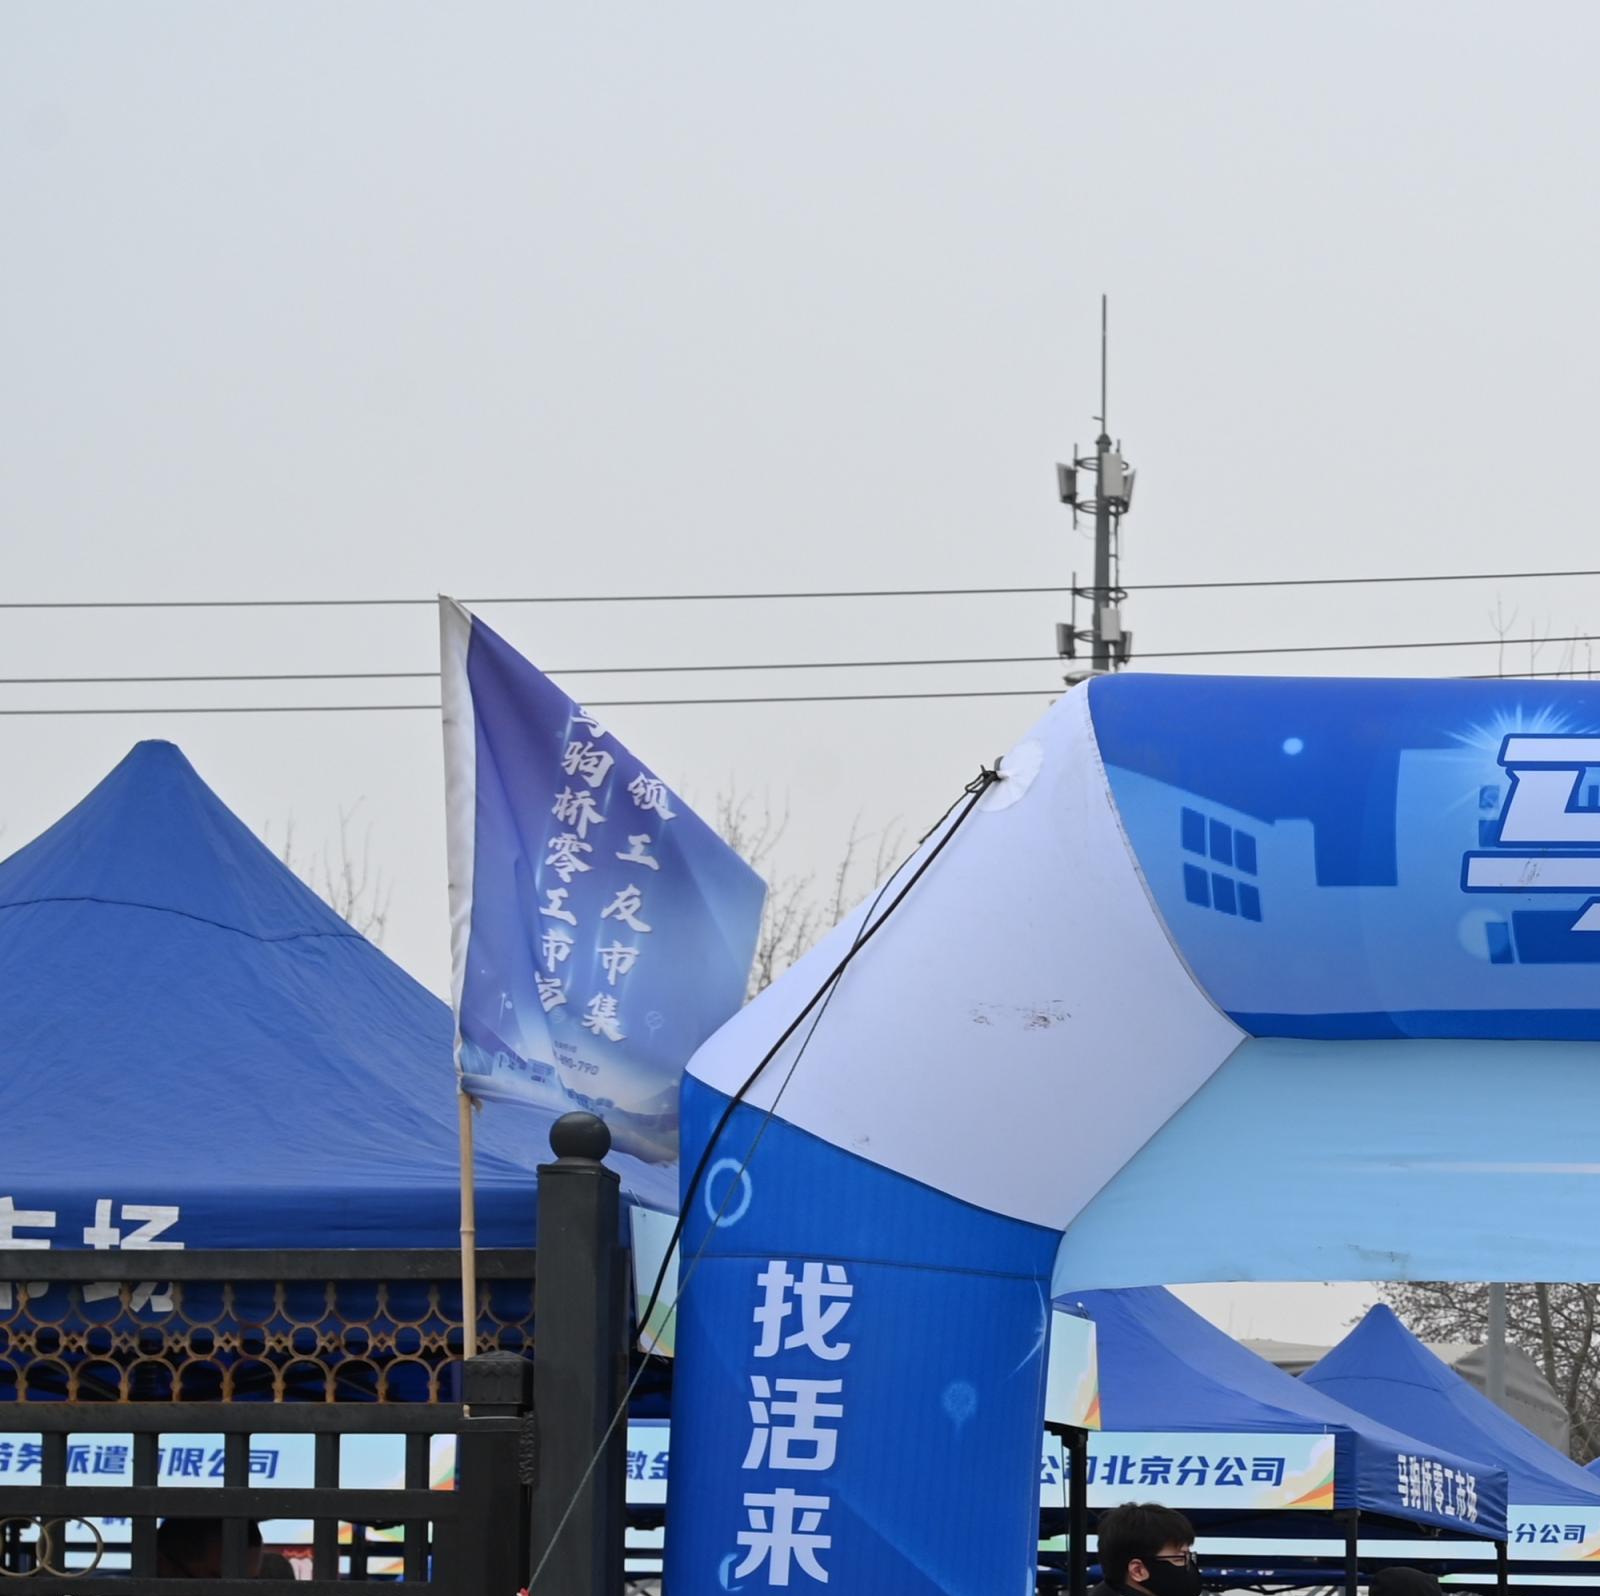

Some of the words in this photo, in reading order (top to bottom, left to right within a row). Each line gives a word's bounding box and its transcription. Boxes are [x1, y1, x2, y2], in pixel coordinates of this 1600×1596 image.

[0, 1196, 186, 1313] 场
[1397, 1453, 1479, 1524] 马驹桥零工市场
[1507, 1522, 1587, 1545] 分公司
